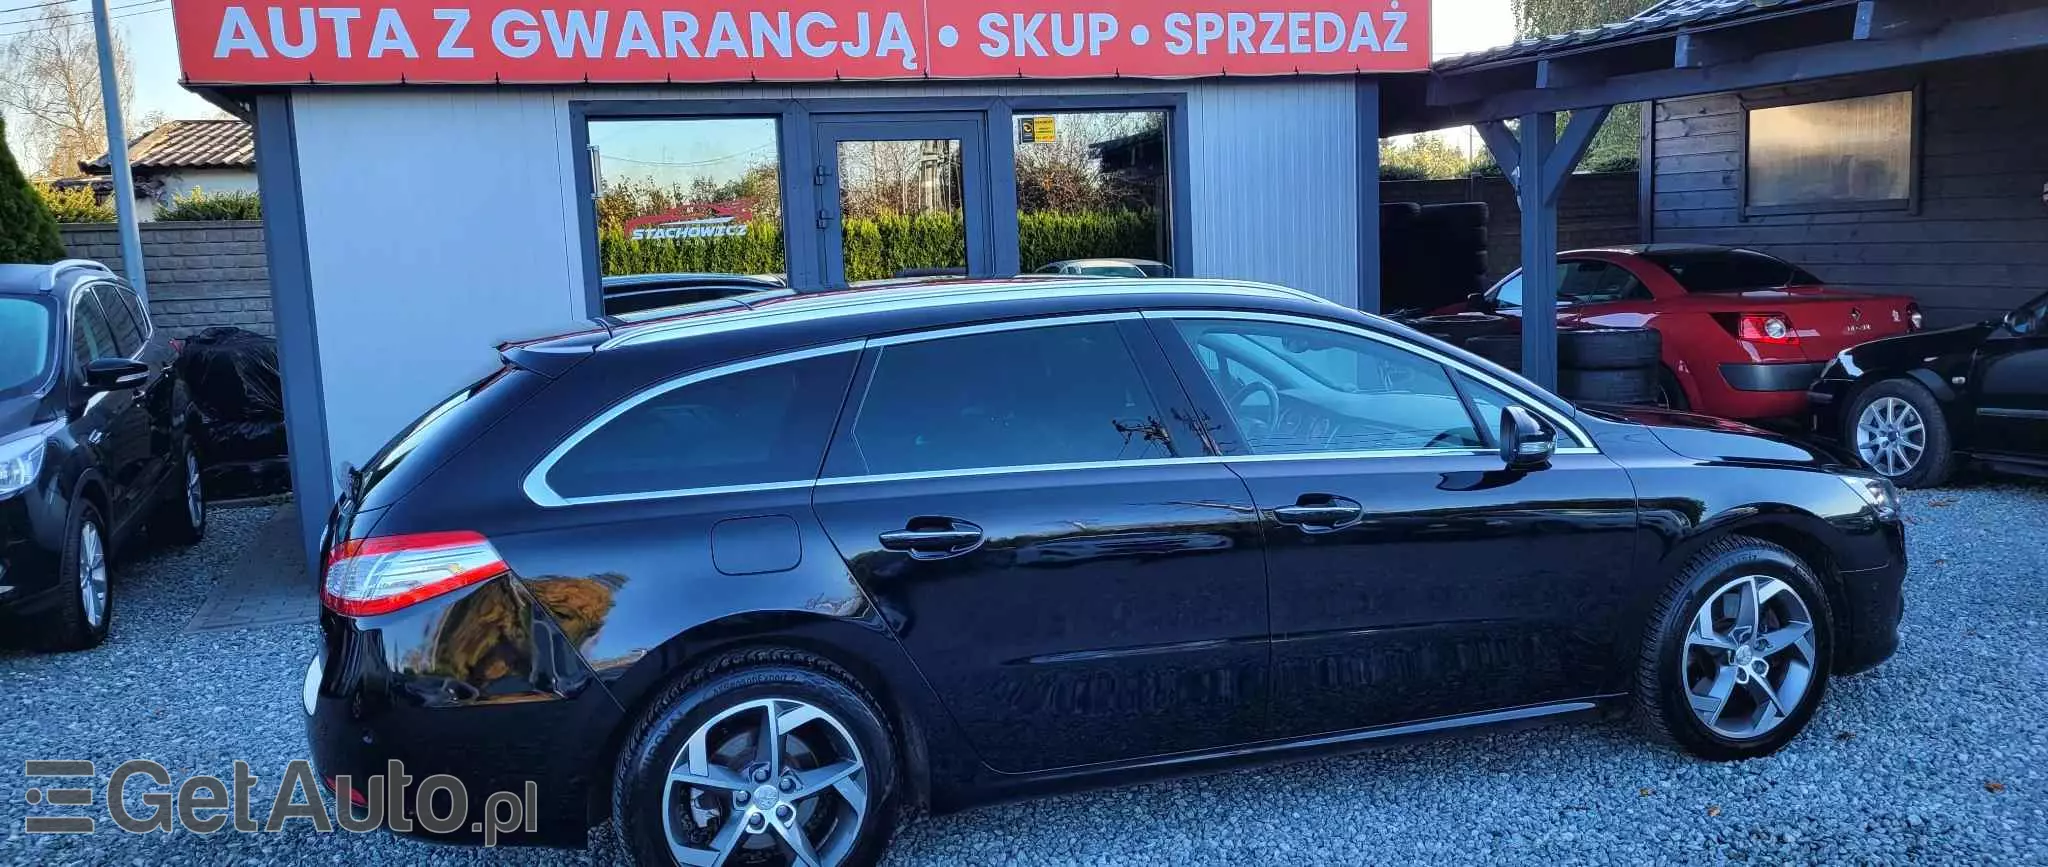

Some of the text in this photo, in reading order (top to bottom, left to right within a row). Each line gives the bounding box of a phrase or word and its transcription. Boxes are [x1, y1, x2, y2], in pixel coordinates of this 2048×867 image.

[213, 0, 1409, 70] AUTA Z GWARANCJĄ SKUP SPRZEDAŻ
[631, 224, 748, 240] STACHOWICZ
